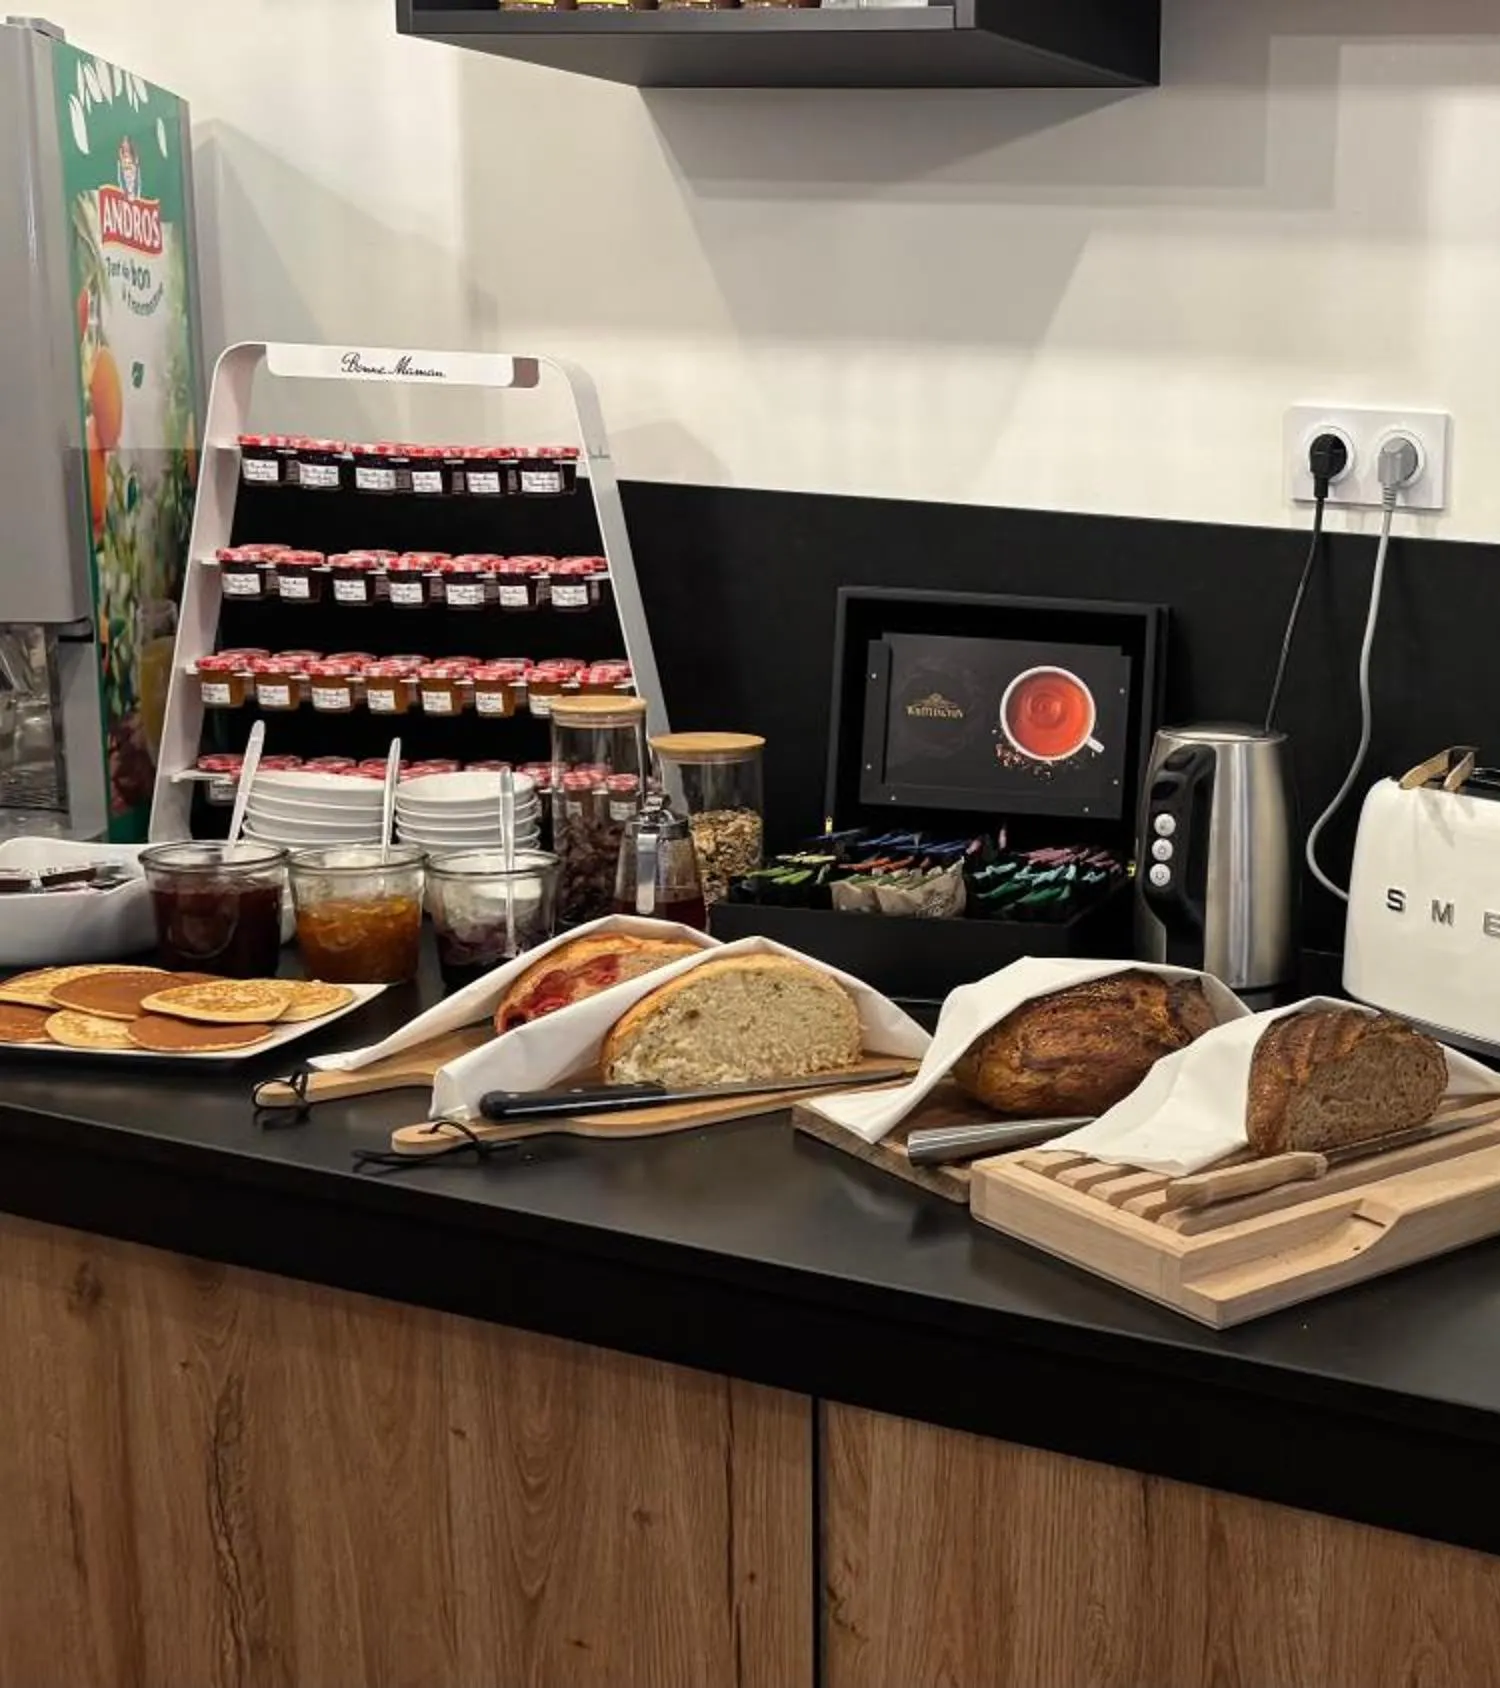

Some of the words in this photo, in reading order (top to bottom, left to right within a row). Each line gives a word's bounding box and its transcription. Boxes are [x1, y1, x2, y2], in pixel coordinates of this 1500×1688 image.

[103, 195, 160, 248] ANDROS
[341, 351, 386, 373] Bonne
[394, 355, 446, 378] Maman
